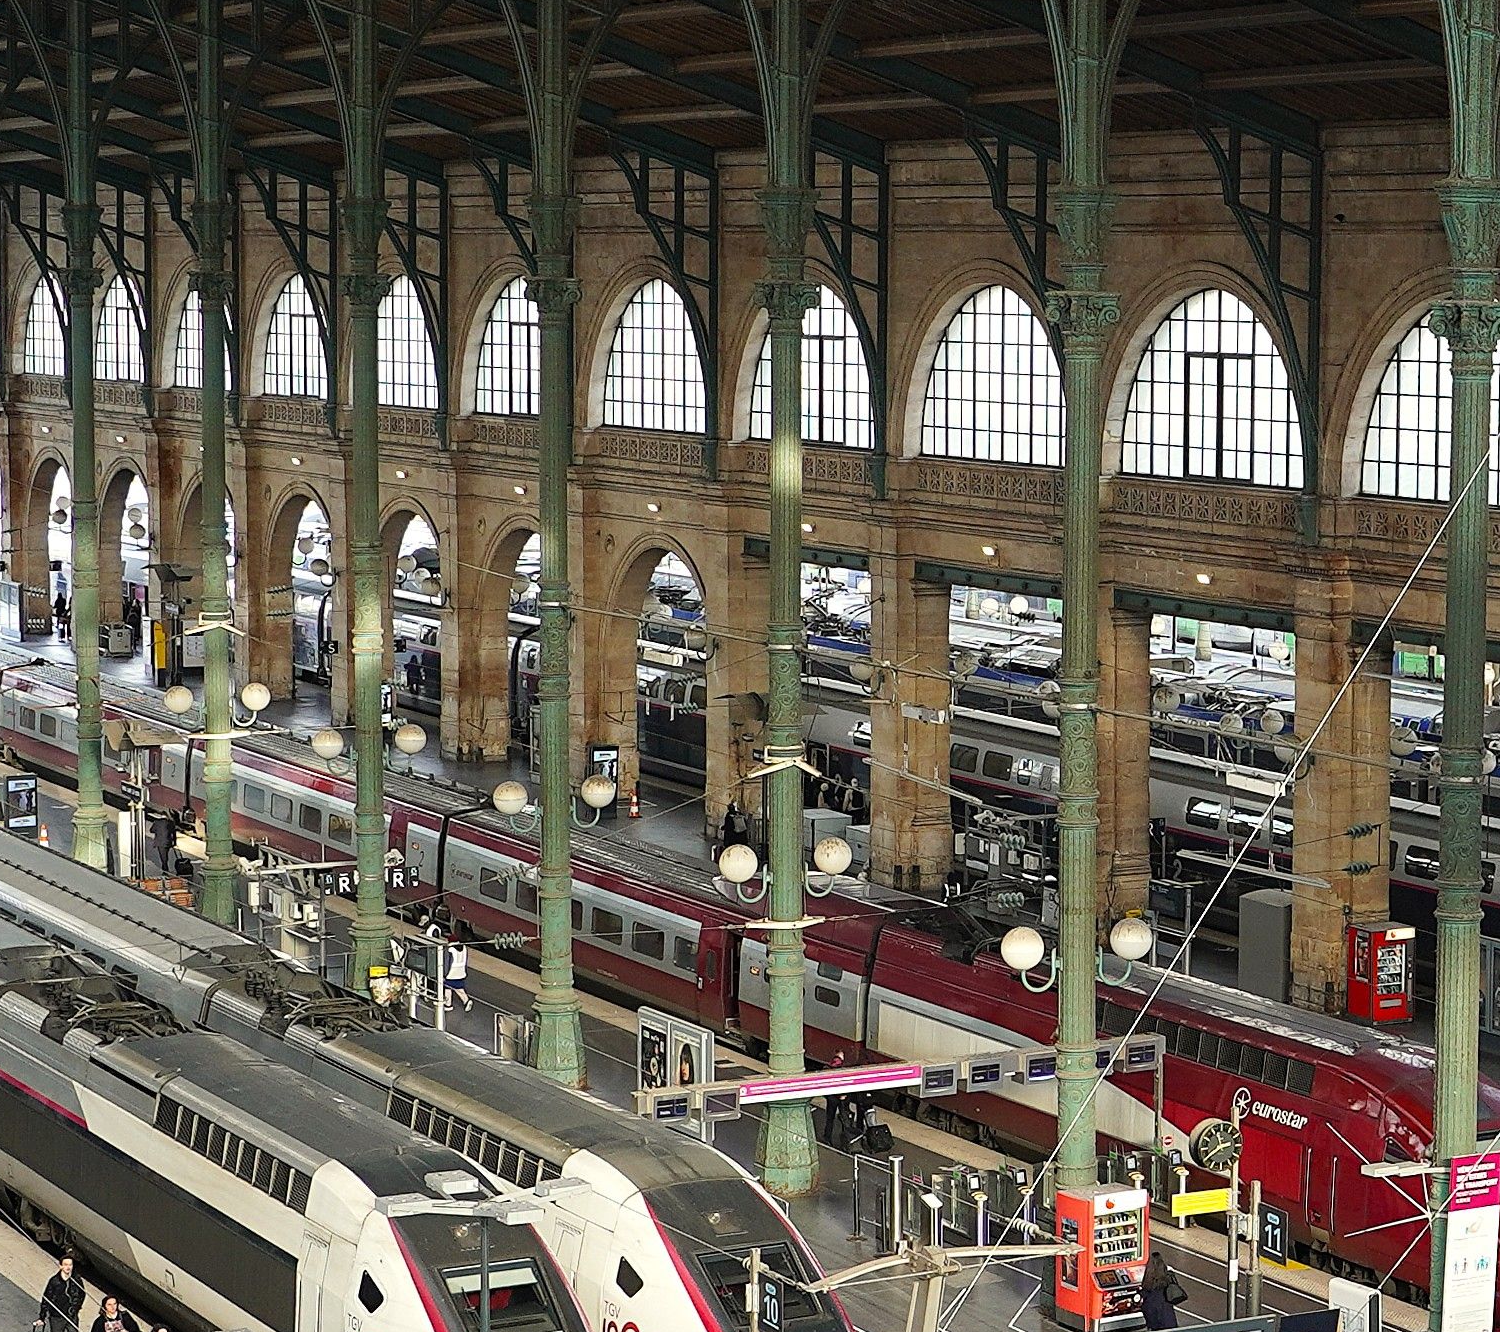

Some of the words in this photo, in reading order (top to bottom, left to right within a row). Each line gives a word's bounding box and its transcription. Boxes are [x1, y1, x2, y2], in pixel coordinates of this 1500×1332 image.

[339, 877, 351, 893] R
[392, 872, 405, 887] R
[1252, 1101, 1308, 1129] eurostar
[1264, 1224, 1281, 1252] 11
[604, 1300, 621, 1318] TGV
[763, 1295, 778, 1325] 10
[347, 1313, 364, 1332] TGV
